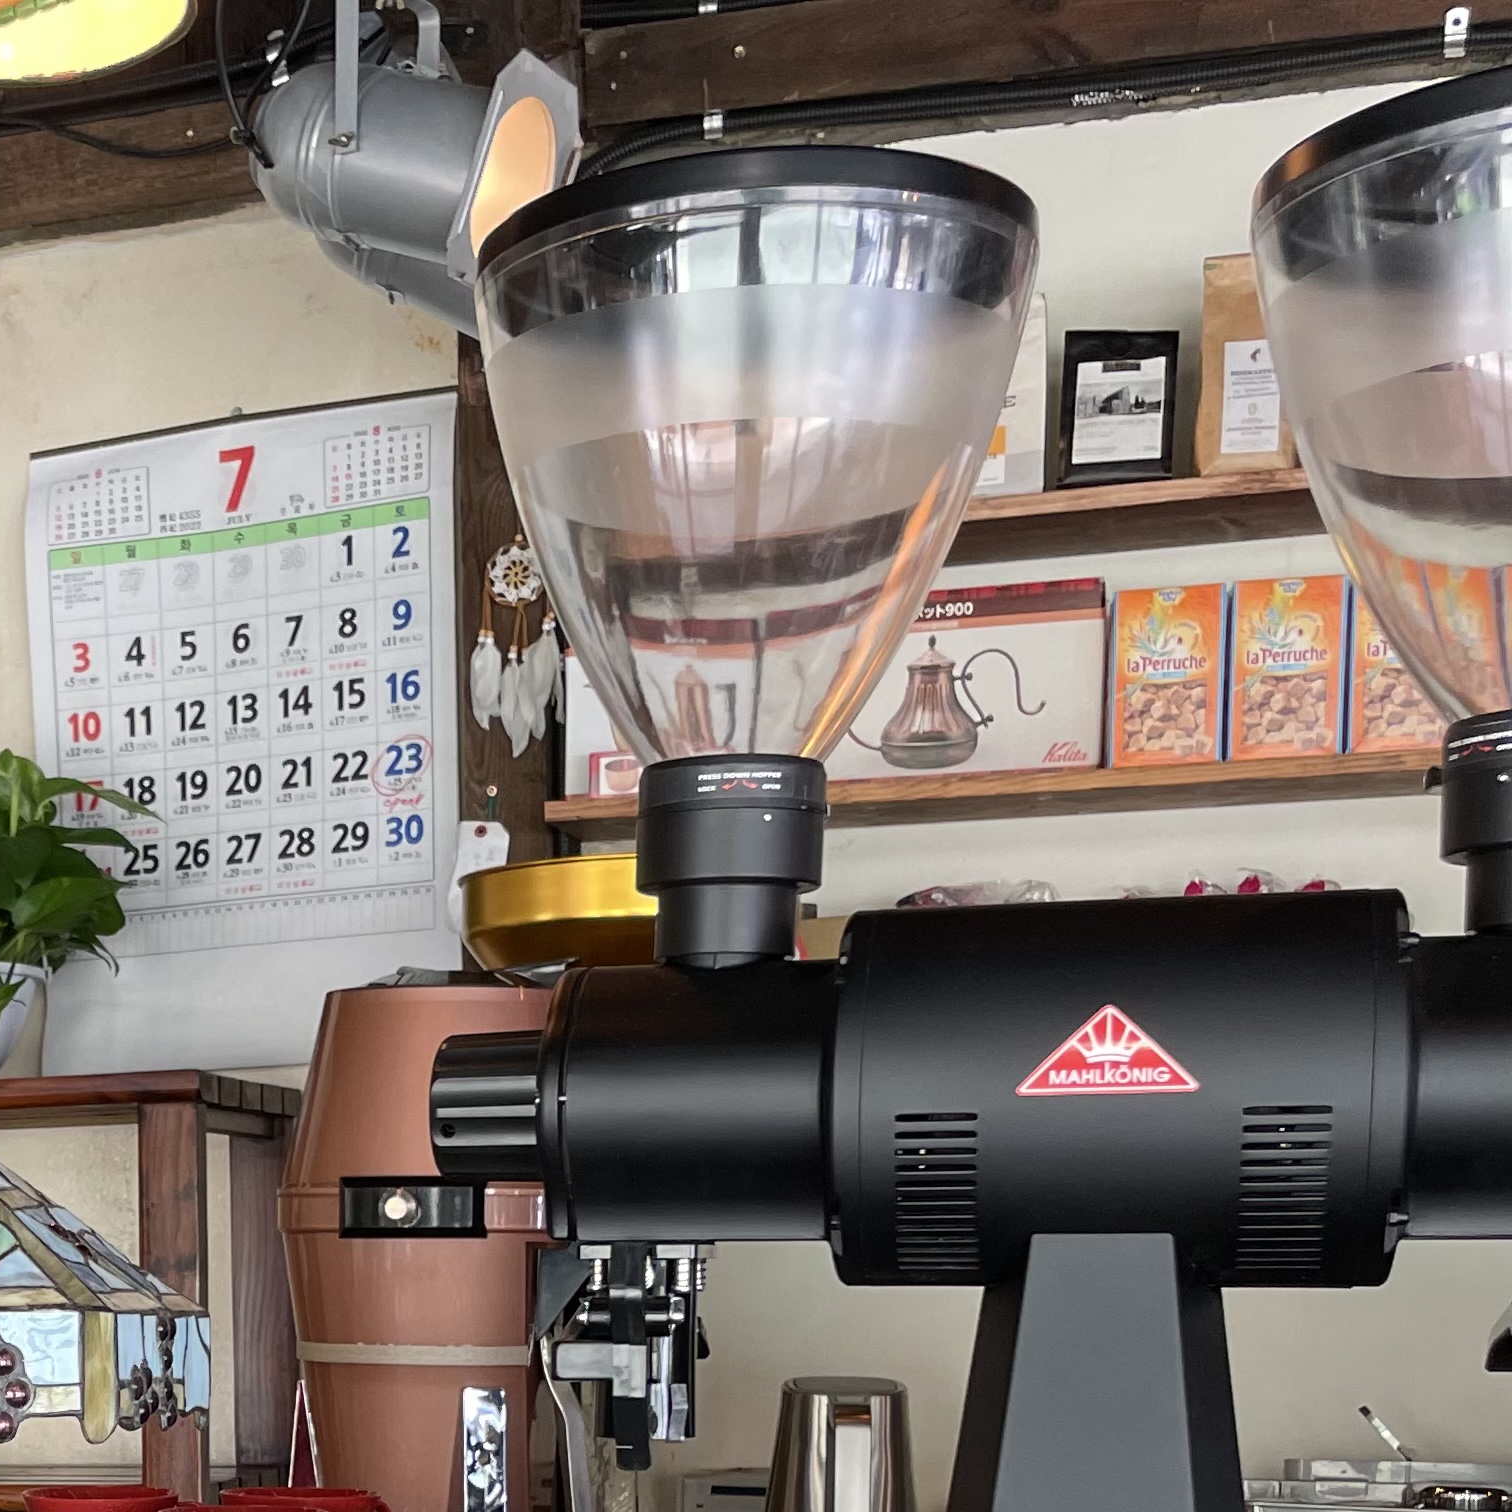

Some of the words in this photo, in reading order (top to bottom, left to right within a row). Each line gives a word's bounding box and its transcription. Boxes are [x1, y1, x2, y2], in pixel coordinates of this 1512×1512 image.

[218, 445, 256, 513] 7
[226, 513, 252, 525] JULY
[234, 532, 245, 544] 수
[340, 516, 352, 527] 금
[342, 536, 352, 565] 1
[392, 526, 410, 558] 2
[73, 643, 90, 672] 3
[126, 637, 145, 666] 4
[181, 631, 196, 661] 5
[233, 623, 250, 653] 6
[285, 615, 302, 647] 7
[339, 608, 357, 638] 8
[393, 600, 411, 630] 9
[1260, 647, 1327, 664] Perruche
[1140, 655, 1206, 672] Perruche
[69, 712, 100, 742] 10
[125, 706, 151, 737] 11
[176, 700, 205, 731] 12
[227, 693, 257, 725] 13
[279, 685, 312, 718] 14
[333, 678, 365, 711] 15
[386, 670, 420, 703] 16
[1042, 742, 1087, 763] Kalita
[123, 776, 156, 806] 18
[176, 770, 207, 801] 19
[226, 764, 261, 796] 20
[282, 757, 311, 789] 21
[332, 750, 368, 783] 22
[385, 743, 422, 776] 23
[123, 844, 159, 876] 25
[175, 839, 209, 871] 26
[227, 833, 261, 865] 27
[278, 828, 314, 859] 28
[332, 822, 369, 853] 29
[386, 814, 423, 847] 30
